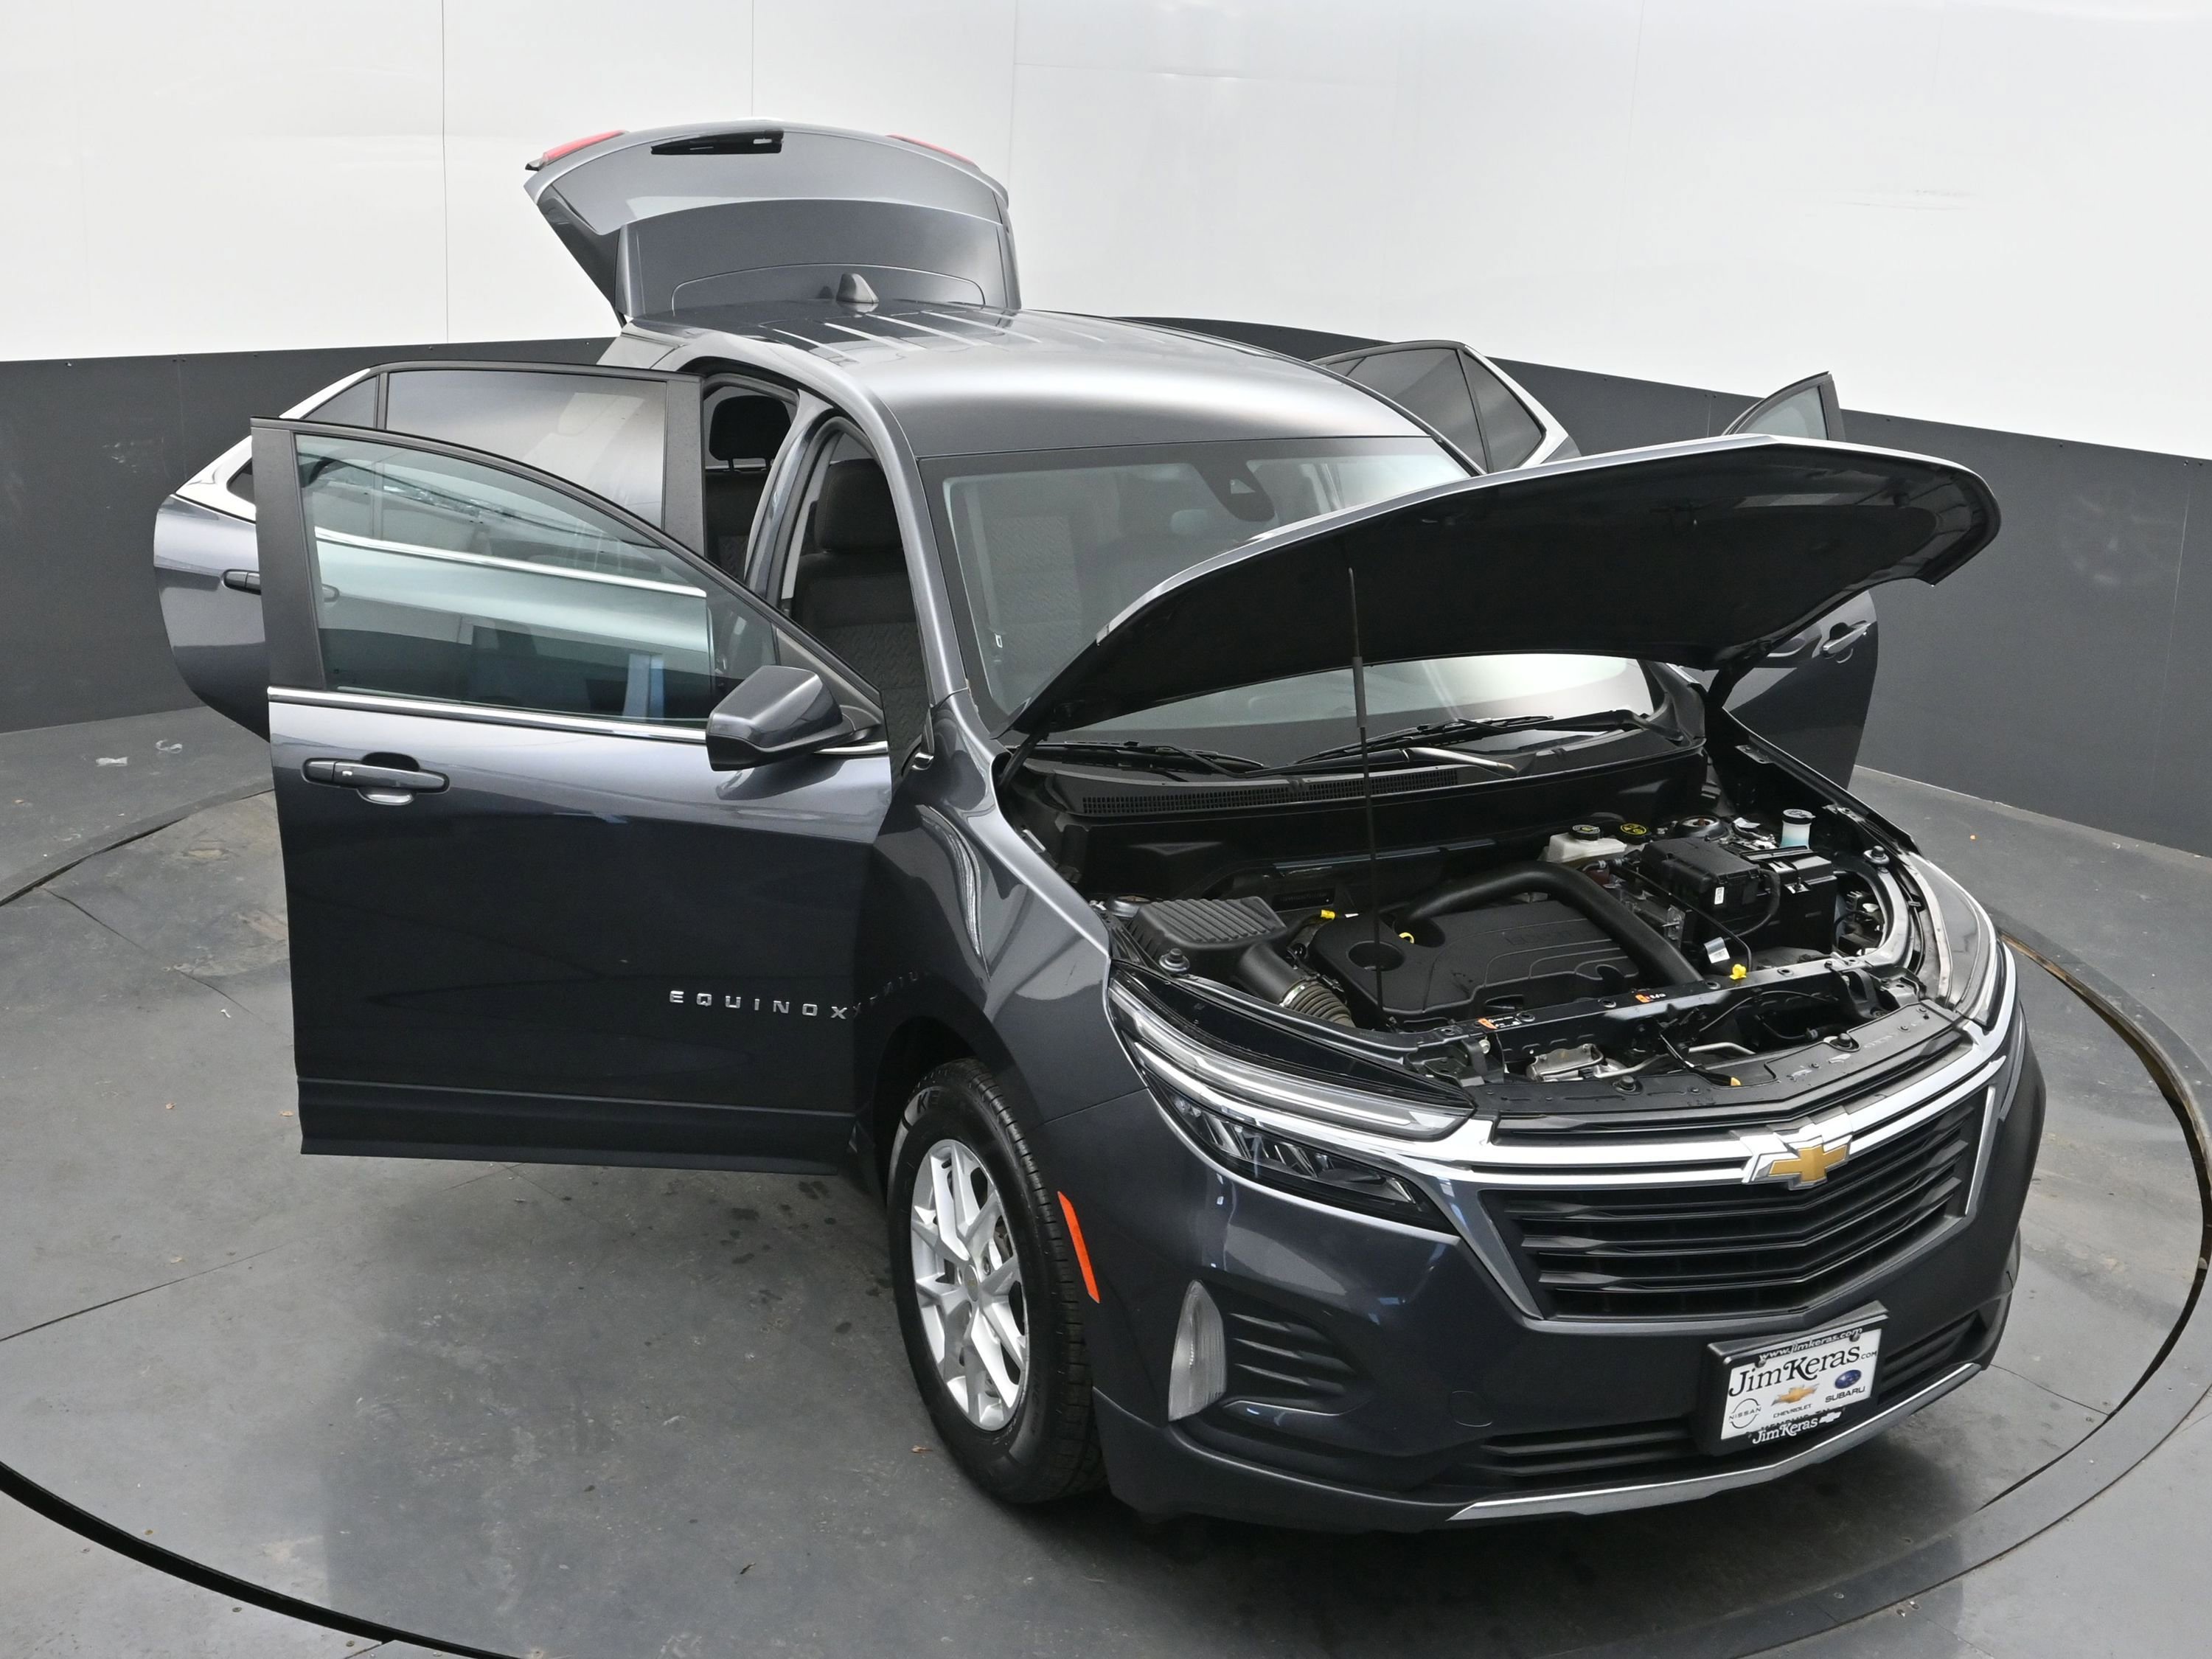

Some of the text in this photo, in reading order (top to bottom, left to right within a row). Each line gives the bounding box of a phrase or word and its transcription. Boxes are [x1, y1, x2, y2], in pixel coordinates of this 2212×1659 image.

[669, 990, 848, 1020] EQUINOX
[1759, 1328, 1863, 1362] www.jimkeras.com
[1825, 1385, 1865, 1403] SUBARU
[1728, 1406, 1761, 1420] NISSAN
[1773, 1403, 1812, 1419] CHEVROLET
